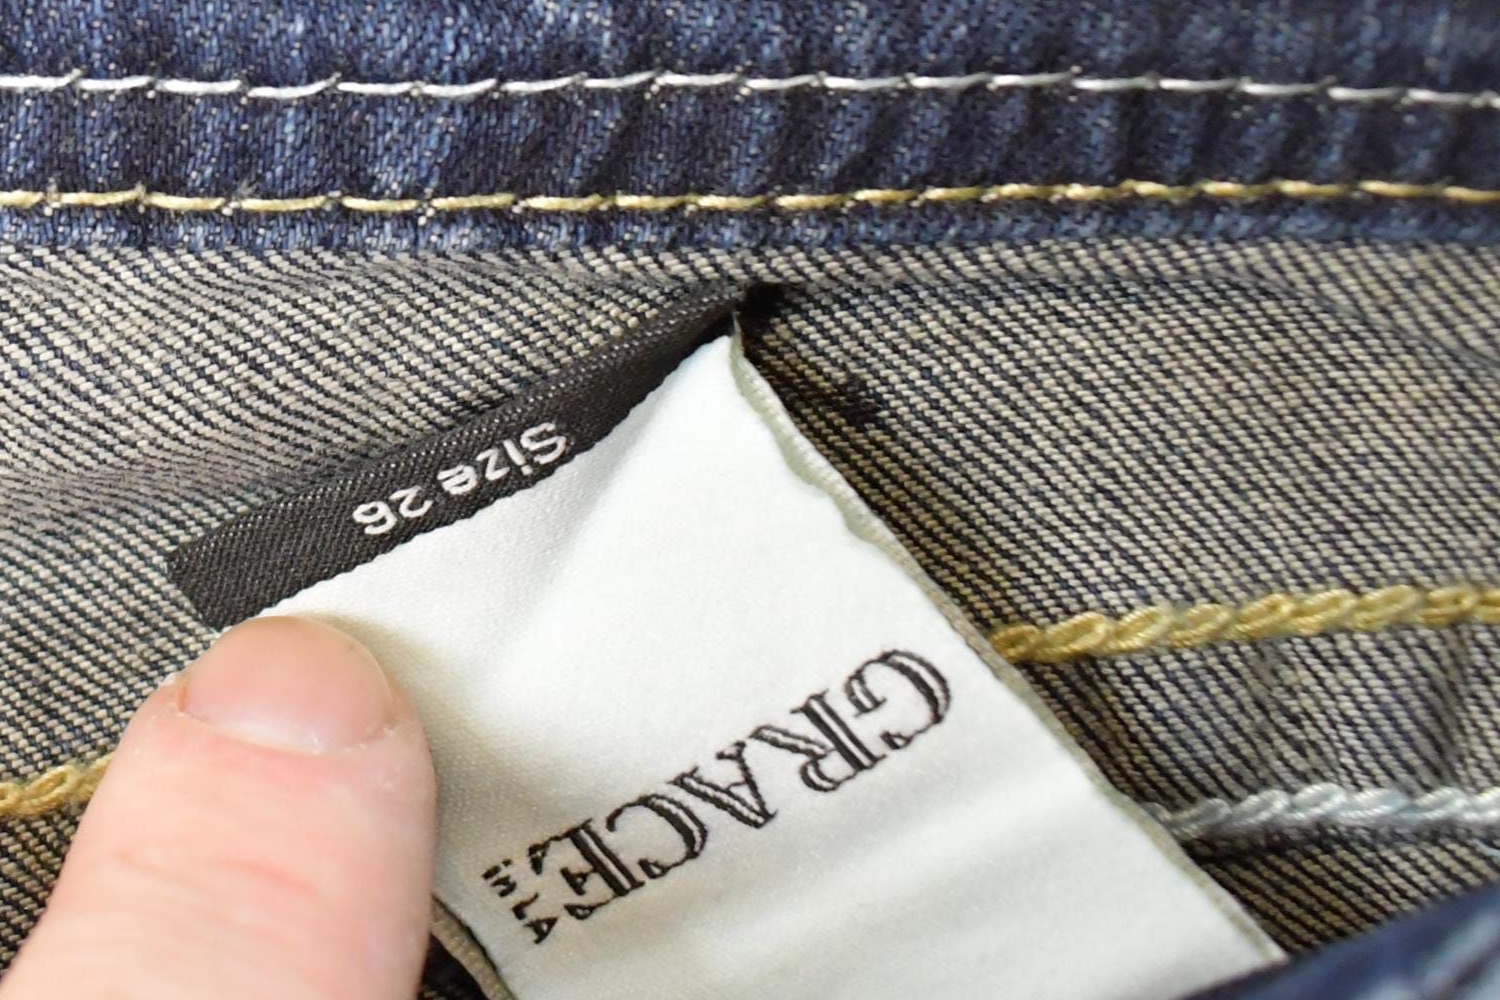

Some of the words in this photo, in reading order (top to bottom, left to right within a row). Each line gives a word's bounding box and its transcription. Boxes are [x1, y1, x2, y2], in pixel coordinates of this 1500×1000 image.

[436, 421, 568, 496] Size
[352, 485, 433, 536] 26
[527, 649, 952, 920] GRACE
[512, 891, 559, 945] LA
